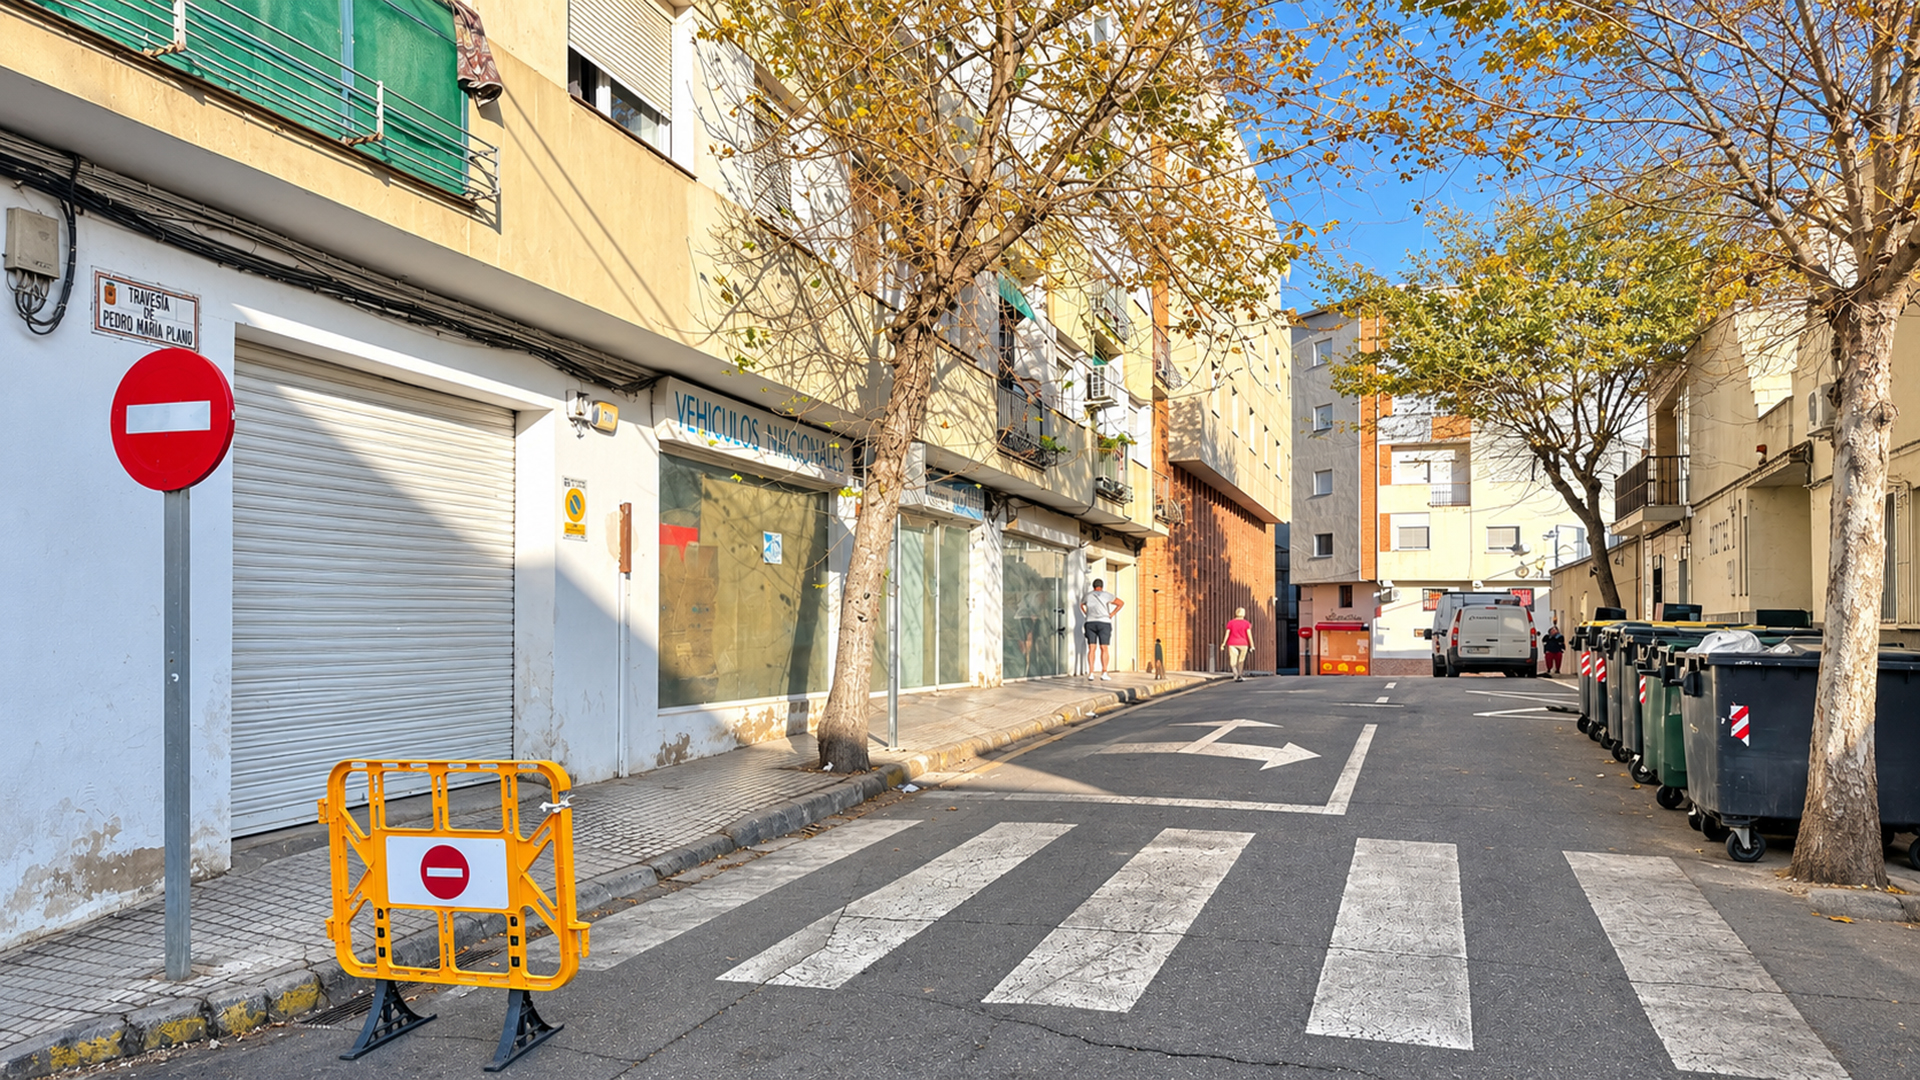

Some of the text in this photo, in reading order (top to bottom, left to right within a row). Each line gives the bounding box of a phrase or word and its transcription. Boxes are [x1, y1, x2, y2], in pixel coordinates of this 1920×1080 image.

[103, 310, 133, 332] PEDRO
[166, 325, 193, 346] PLANO
[144, 307, 155, 321] DE
[675, 391, 844, 472] VEHICULOS NACIONALES
